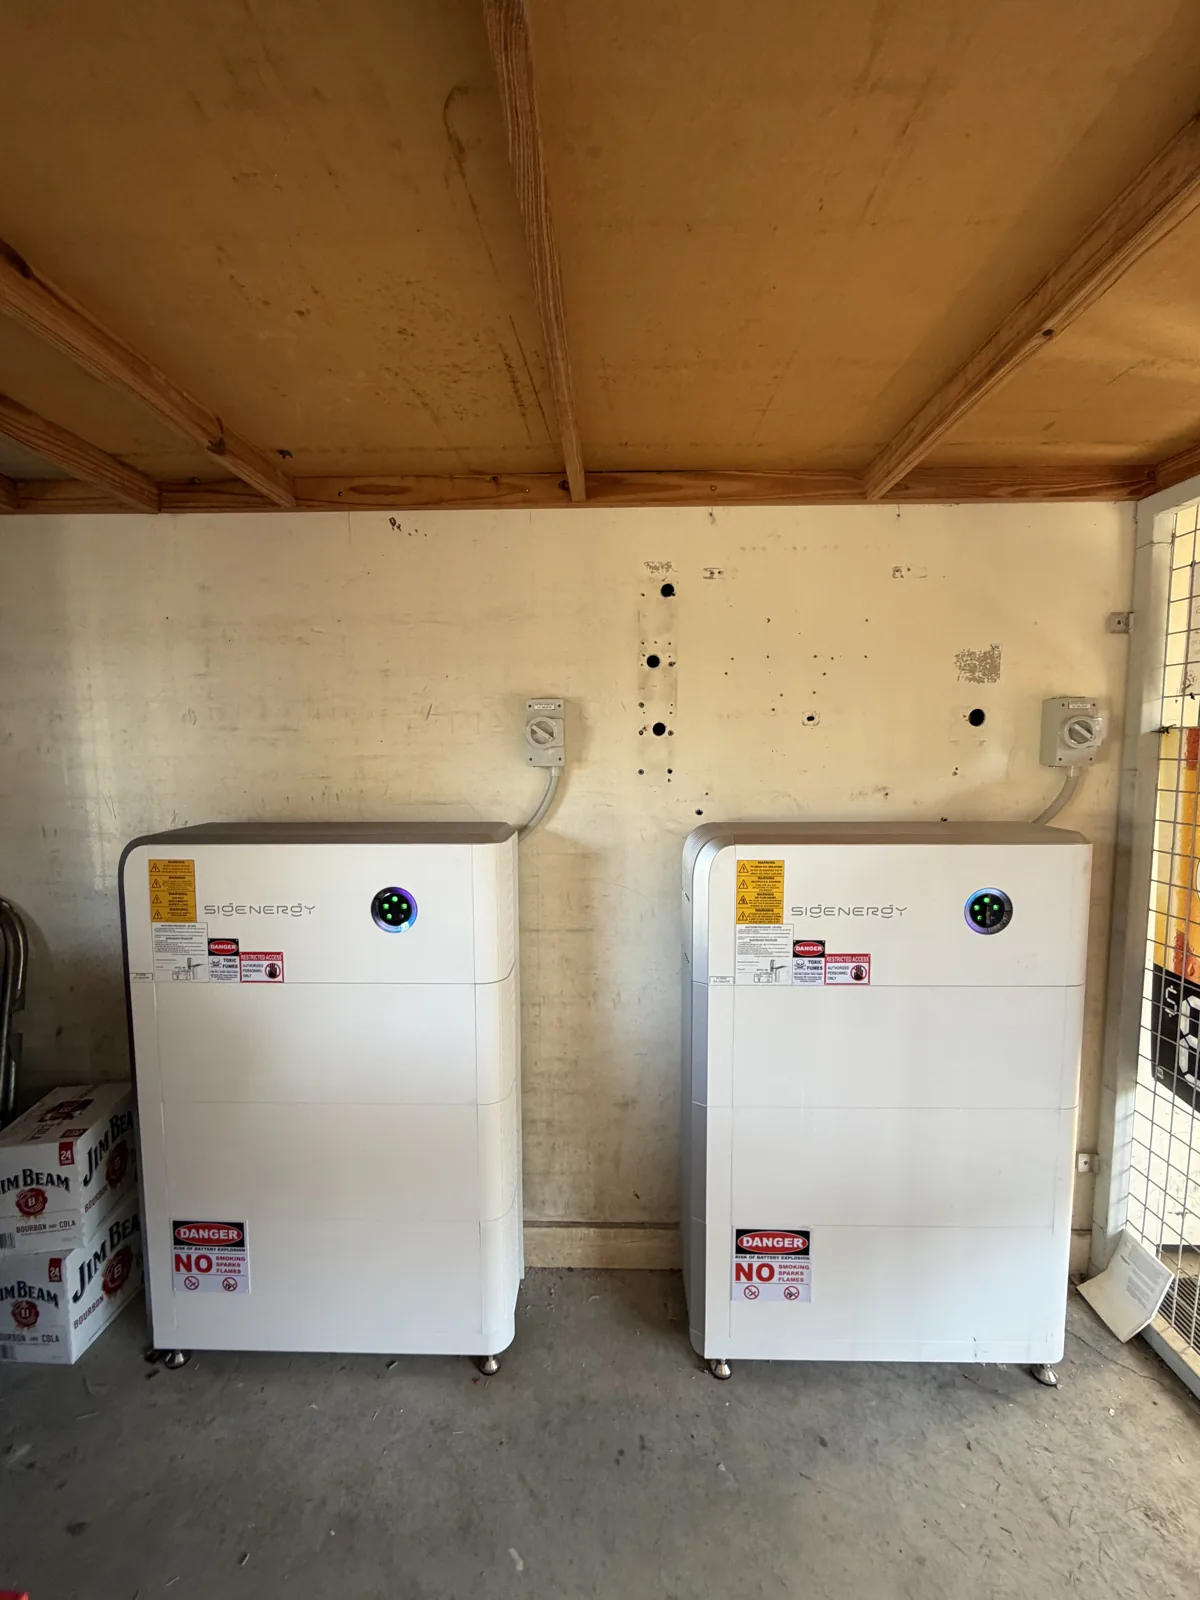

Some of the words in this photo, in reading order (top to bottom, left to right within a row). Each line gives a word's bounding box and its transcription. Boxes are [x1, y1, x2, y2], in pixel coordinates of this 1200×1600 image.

[60, 1150, 72, 1160] 24
[83, 1130, 109, 1187] JIM
[108, 1110, 134, 1144] BEA
[0, 1174, 20, 1195] IM
[22, 1168, 70, 1192] BEAM
[16, 1223, 47, 1234] BOURBON
[59, 1220, 76, 1228] COLA
[180, 1228, 238, 1240] DANGER
[743, 1237, 804, 1248] DANGER
[72, 1239, 108, 1304] JIM
[109, 1213, 141, 1251] BEA
[174, 1253, 213, 1273] NO
[49, 1267, 60, 1277] 24
[735, 1262, 775, 1282] NO
[0, 1285, 15, 1301] IM
[16, 1280, 59, 1309] BEAM
[73, 1296, 105, 1330] BOURBON
